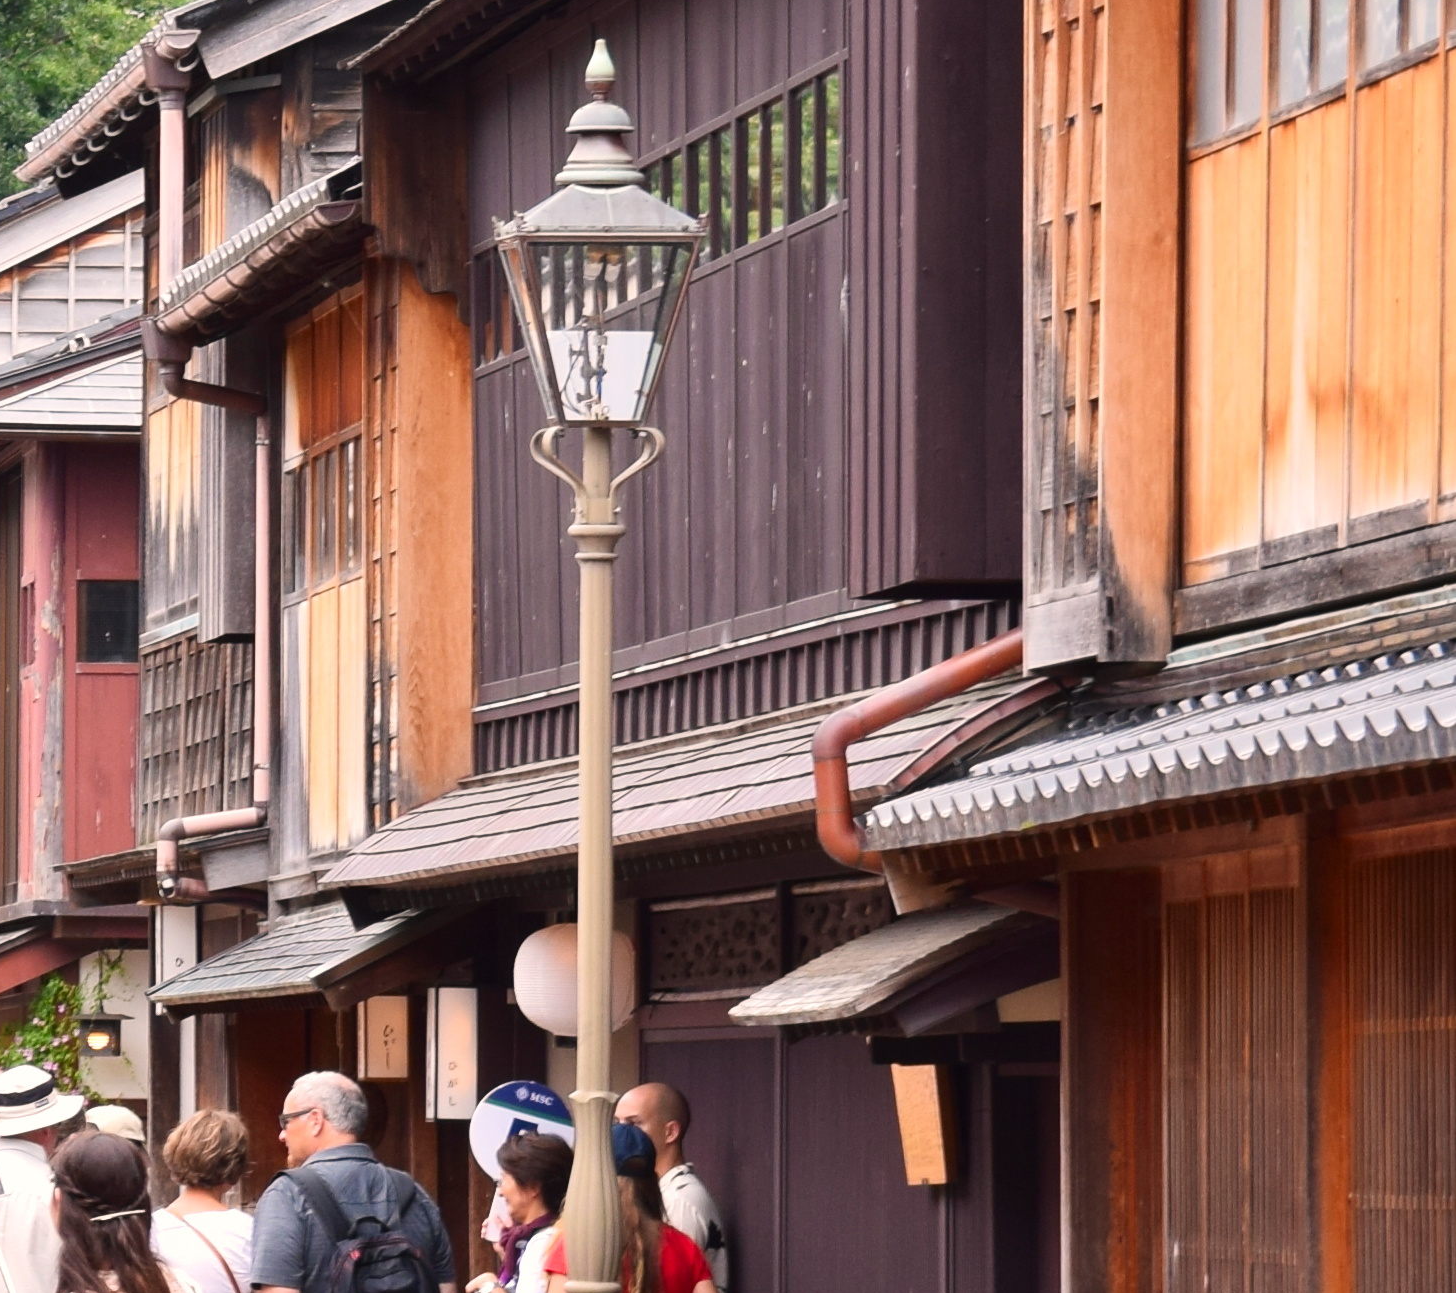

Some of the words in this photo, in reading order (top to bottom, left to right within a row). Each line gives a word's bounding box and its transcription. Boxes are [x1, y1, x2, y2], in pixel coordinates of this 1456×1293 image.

[383, 1024, 396, 1070] ひがし
[448, 1061, 458, 1106] ひがし
[530, 1091, 554, 1106] MSC
